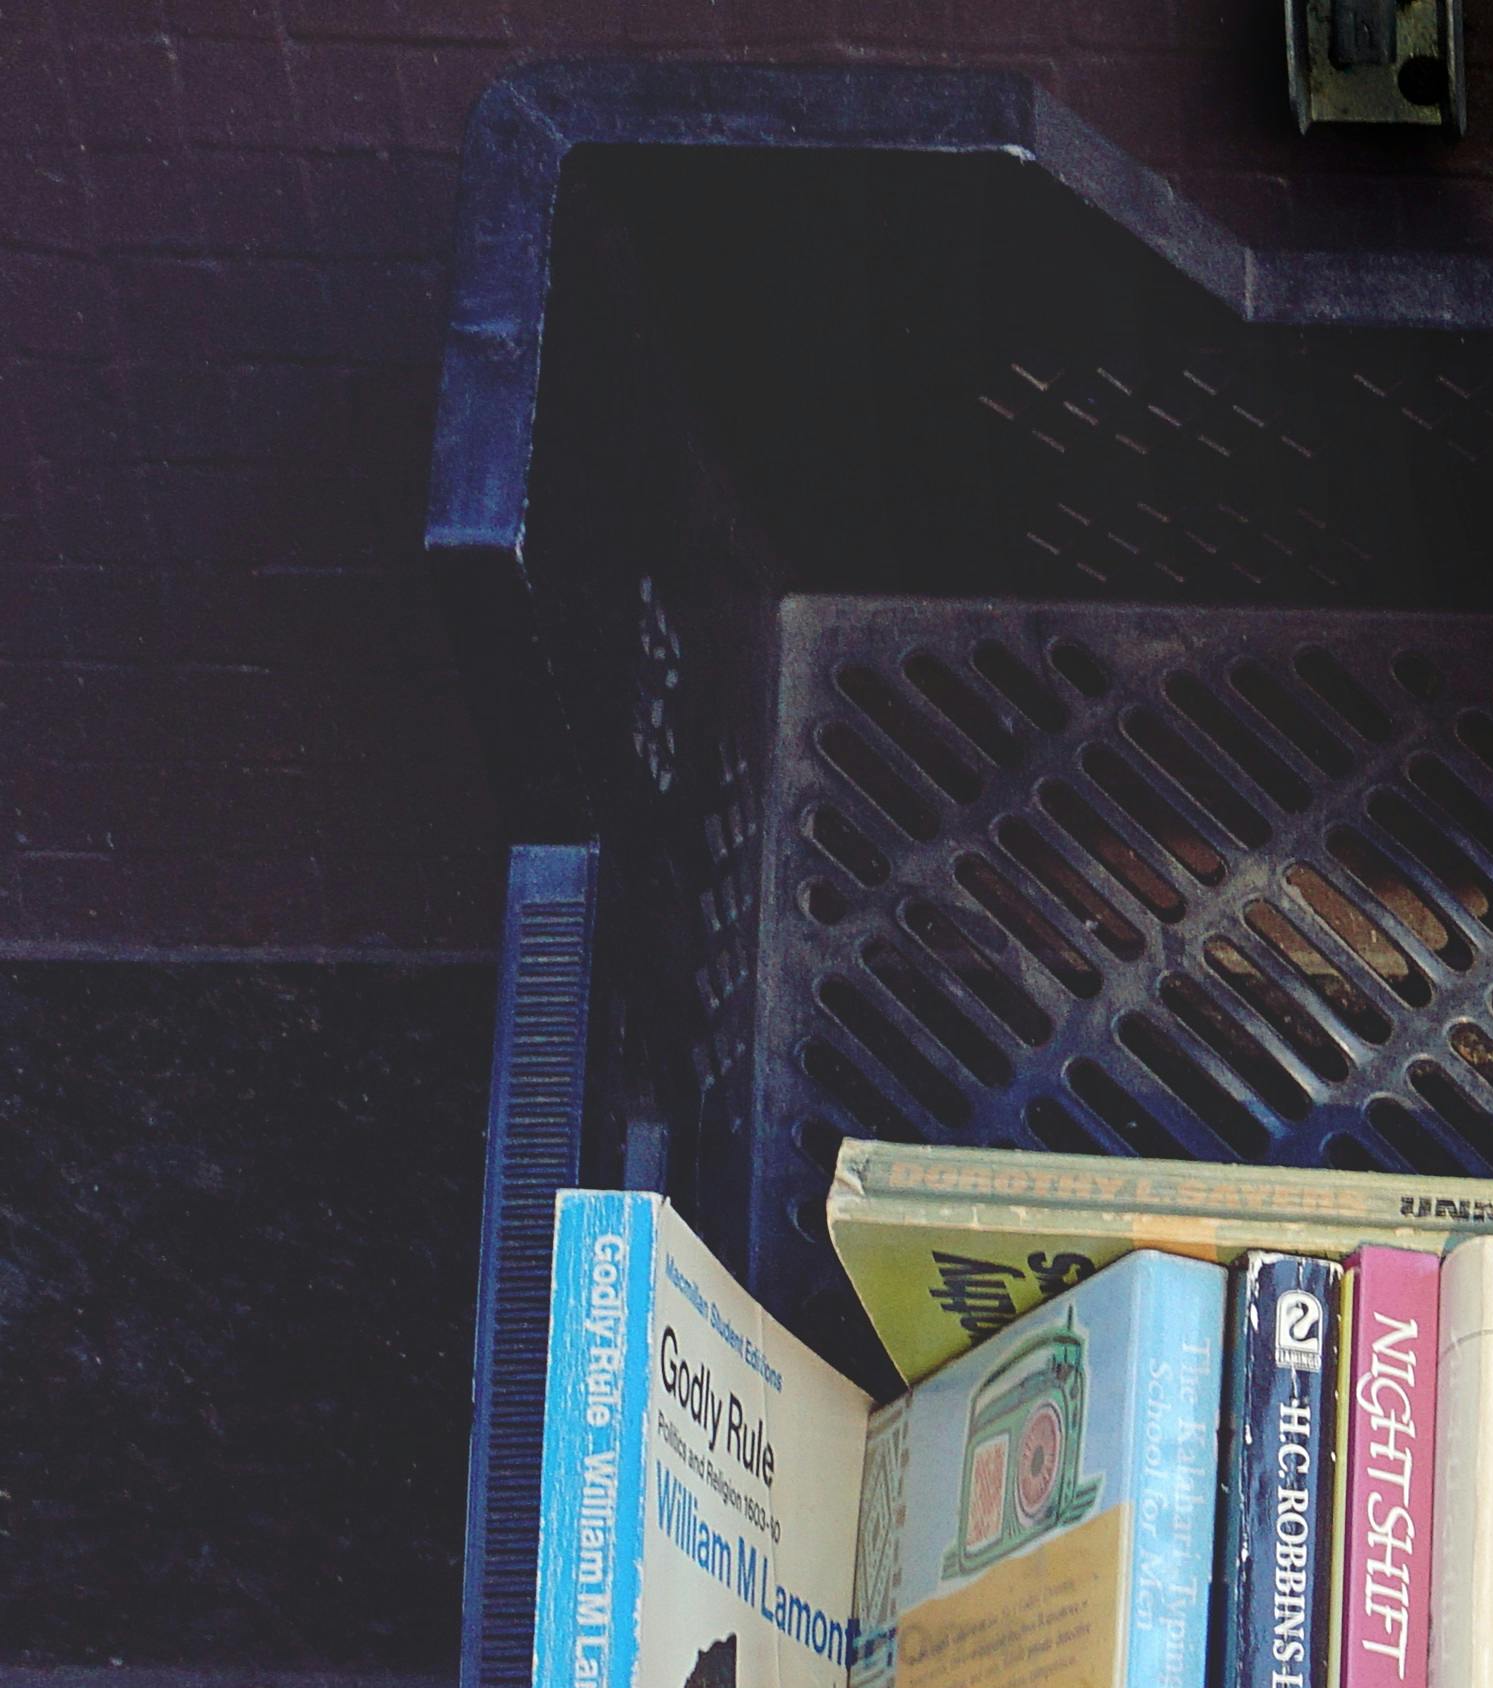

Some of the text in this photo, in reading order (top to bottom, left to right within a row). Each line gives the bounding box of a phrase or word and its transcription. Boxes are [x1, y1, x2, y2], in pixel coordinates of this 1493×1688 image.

[888, 1162, 1124, 1202] DOROTHY
[584, 1233, 626, 1428] Godly Rule
[710, 1301, 743, 1360] Student
[744, 1337, 783, 1393] Editions
[1181, 1337, 1210, 1404] The
[657, 1408, 687, 1463] Politics
[688, 1446, 706, 1479] and
[706, 1459, 743, 1512] Religion
[660, 1326, 775, 1488] Godly Rule
[1277, 1402, 1310, 1481] H.C.
[578, 1451, 616, 1583] William
[1135, 1357, 1174, 1630] School for Men
[1174, 1416, 1207, 1561] Kalahari
[1356, 1311, 1418, 1680] NIGHT SHIFT
[575, 1593, 610, 1625] M
[656, 1459, 732, 1588] William
[736, 1536, 757, 1608] M
[760, 1557, 860, 1668] Lamont
[1271, 1487, 1310, 1661] ROBBINS
